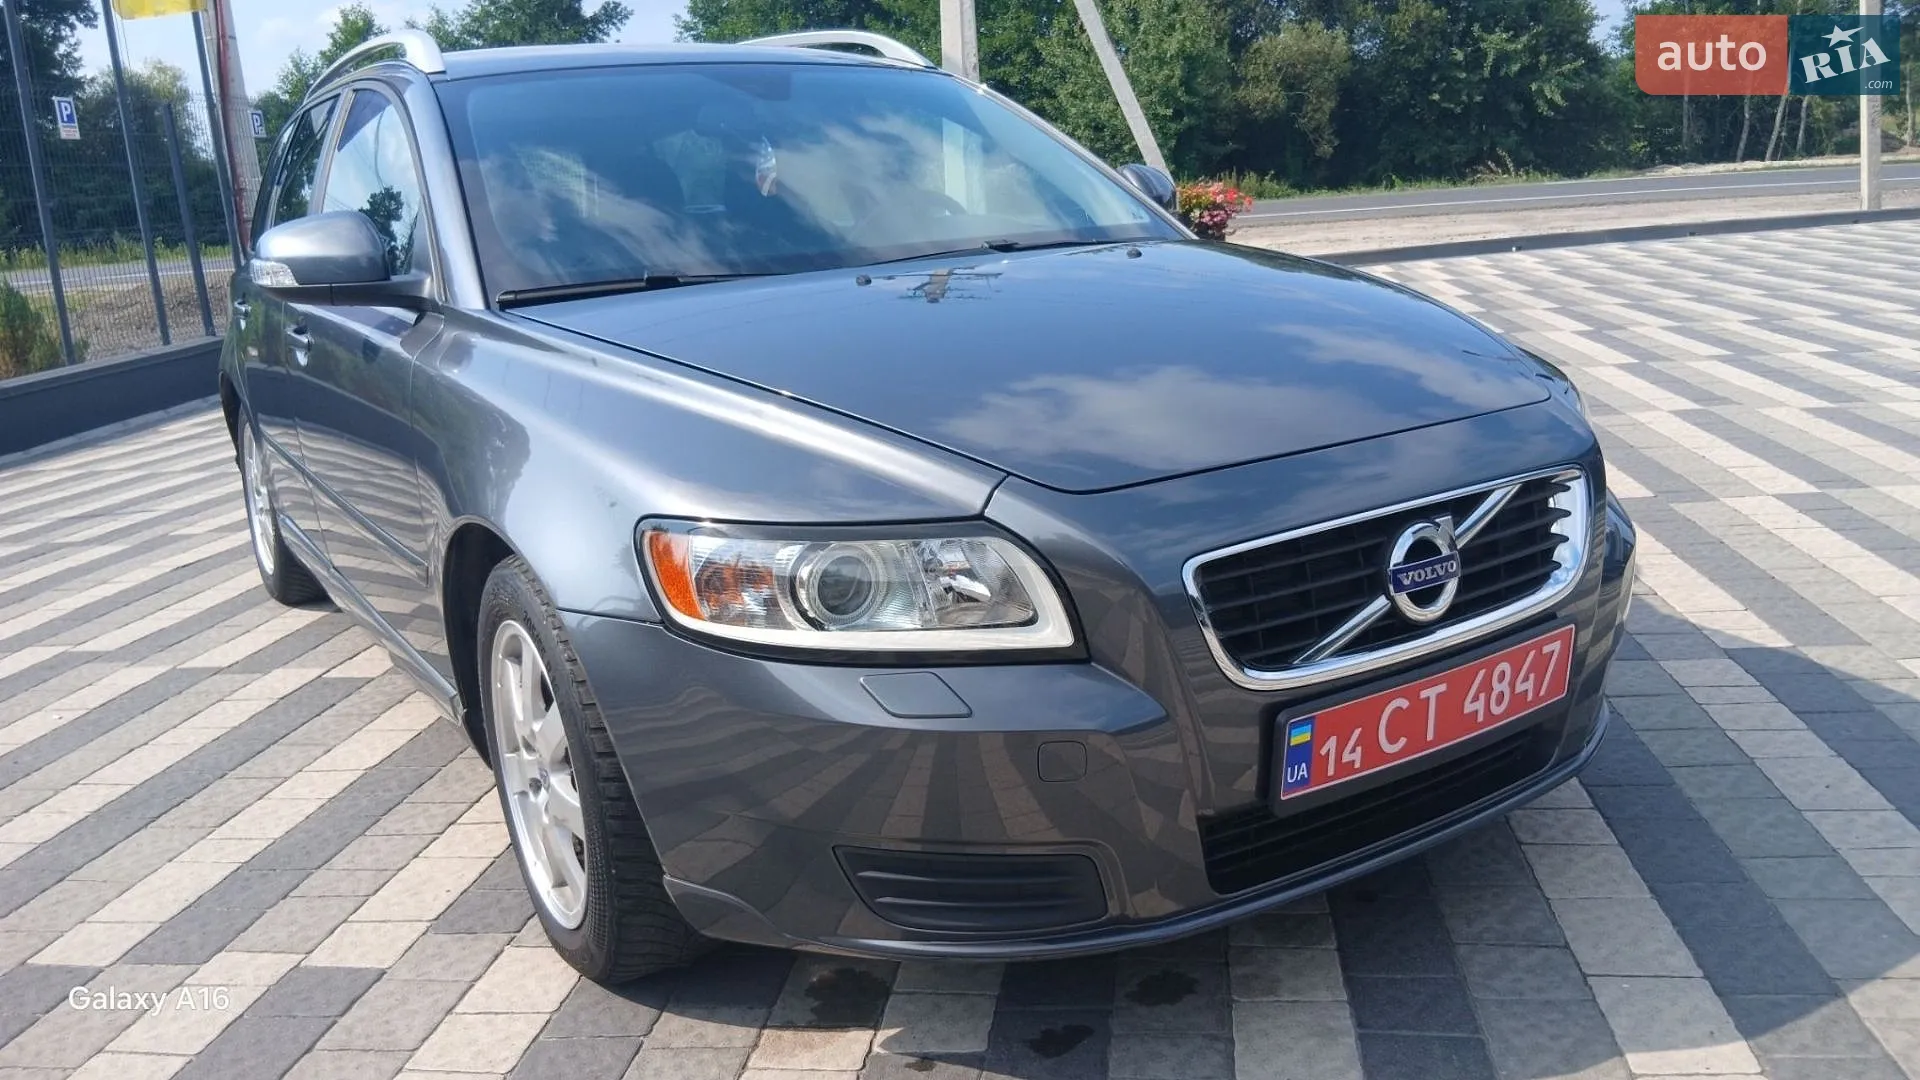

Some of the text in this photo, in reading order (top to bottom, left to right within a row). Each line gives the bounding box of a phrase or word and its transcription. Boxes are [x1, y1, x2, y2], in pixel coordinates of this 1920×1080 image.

[60, 101, 71, 122] P
[1397, 560, 1457, 586] VOLVO
[1319, 640, 1562, 777] 14 CT 4847
[1287, 762, 1308, 783] UA
